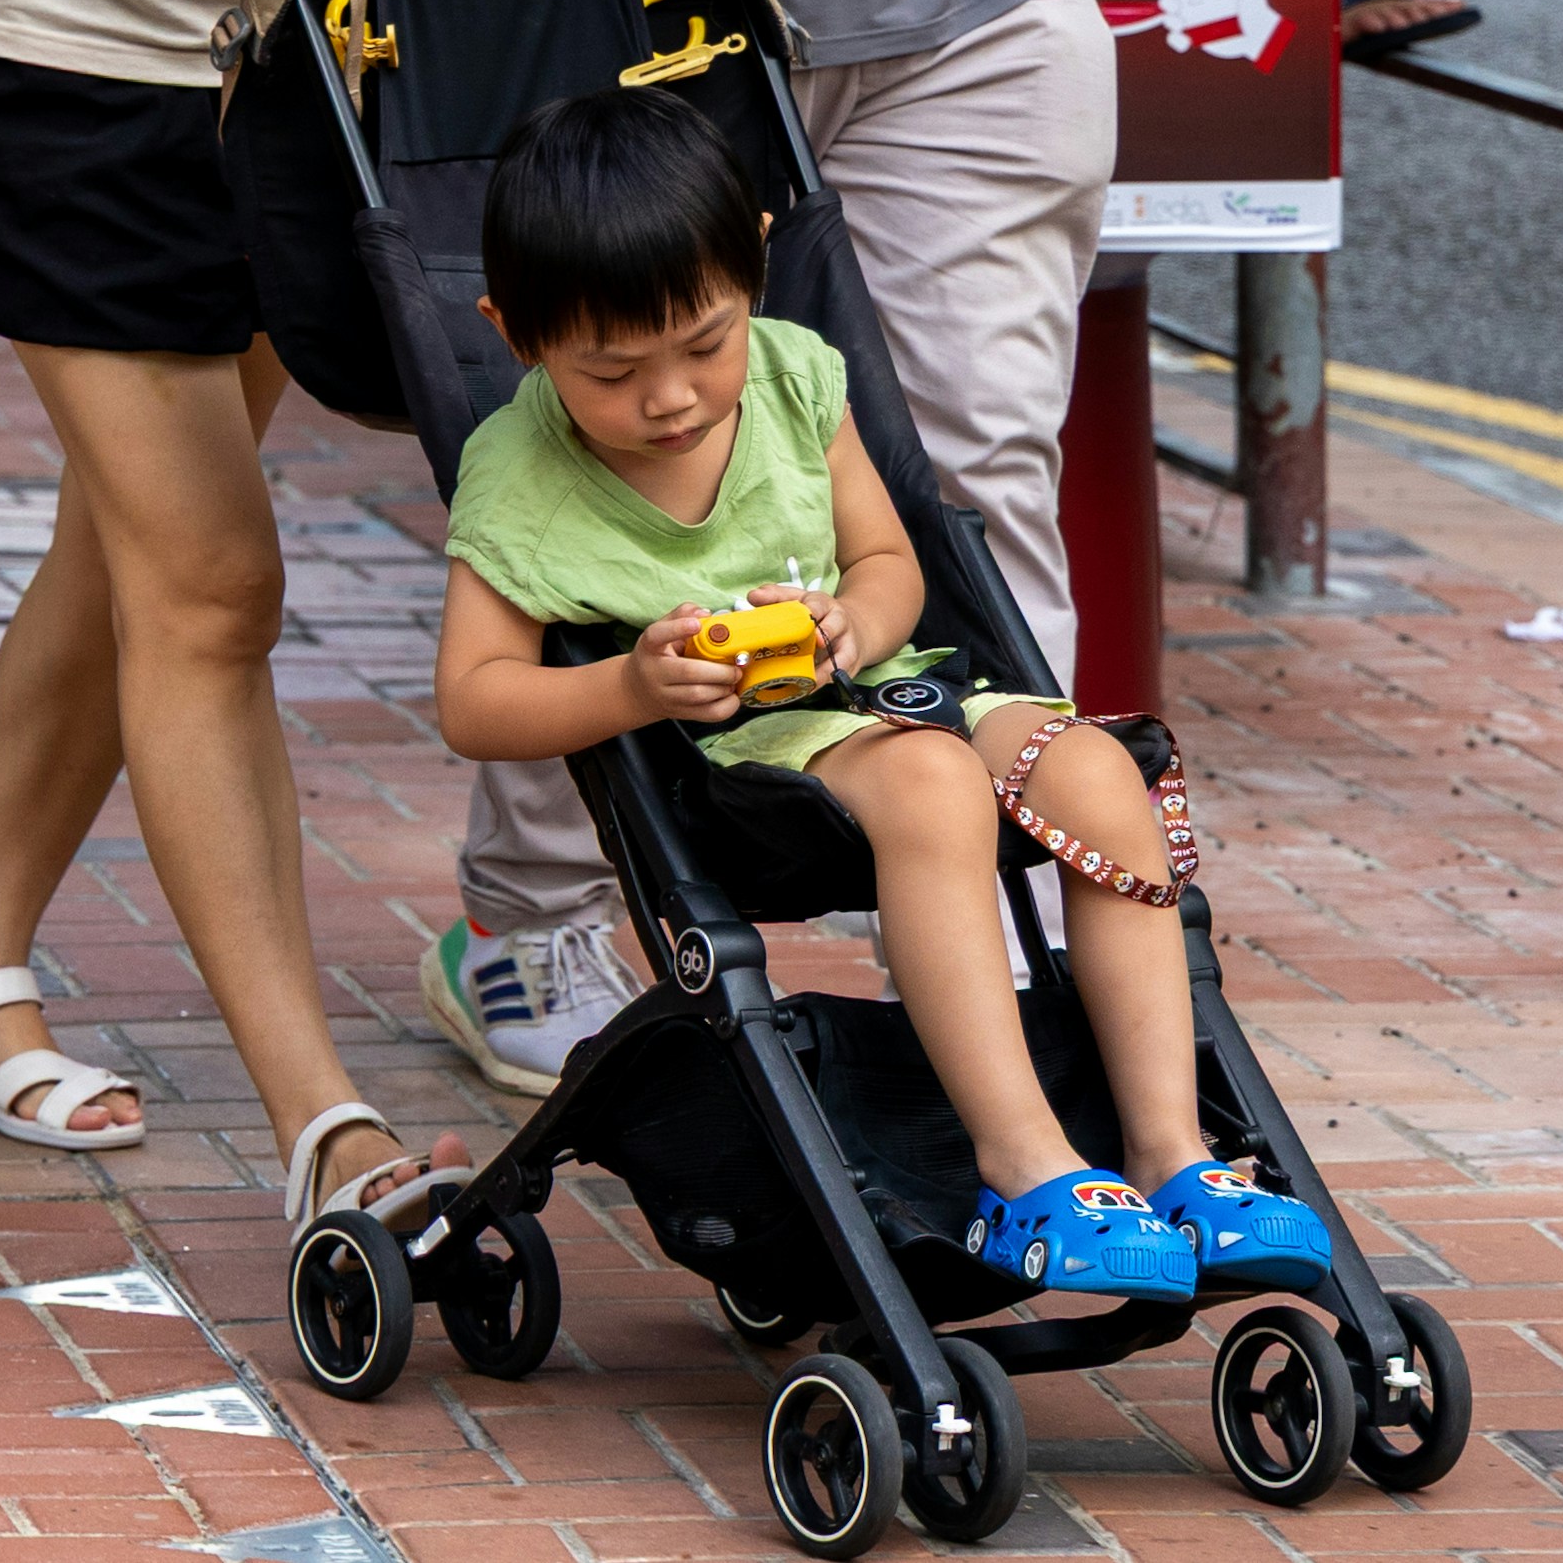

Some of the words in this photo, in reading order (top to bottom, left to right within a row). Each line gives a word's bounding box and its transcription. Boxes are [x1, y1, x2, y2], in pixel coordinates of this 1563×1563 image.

[1159, 778, 1185, 789] CHIP
[1163, 818, 1191, 829] DALE
[1063, 839, 1081, 862] CHIP
[1171, 846, 1197, 857] CHIP
[1094, 859, 1114, 883] DALE
[681, 945, 704, 976] gb
